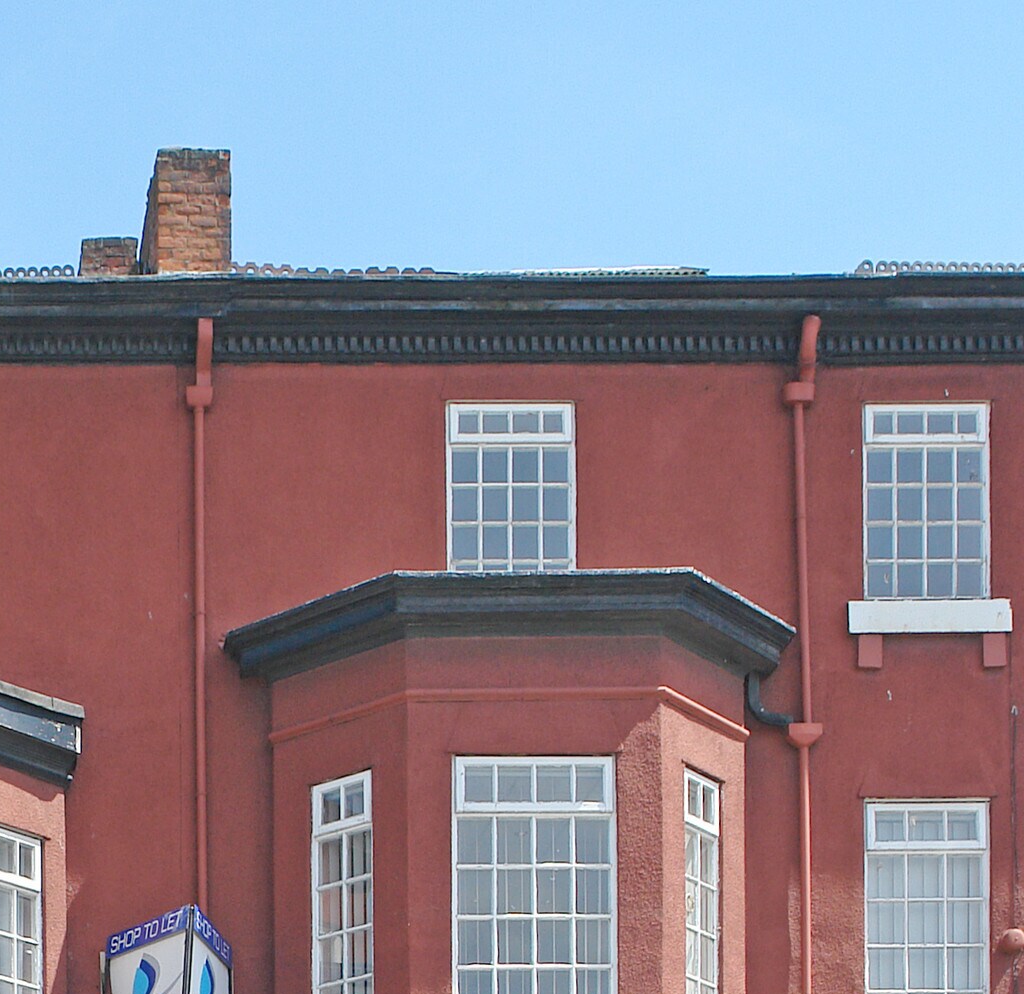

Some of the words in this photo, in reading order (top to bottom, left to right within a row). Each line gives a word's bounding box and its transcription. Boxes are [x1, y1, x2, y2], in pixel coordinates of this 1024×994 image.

[110, 927, 142, 953] SHOP
[143, 920, 159, 939] TO
[161, 910, 183, 932] LET
